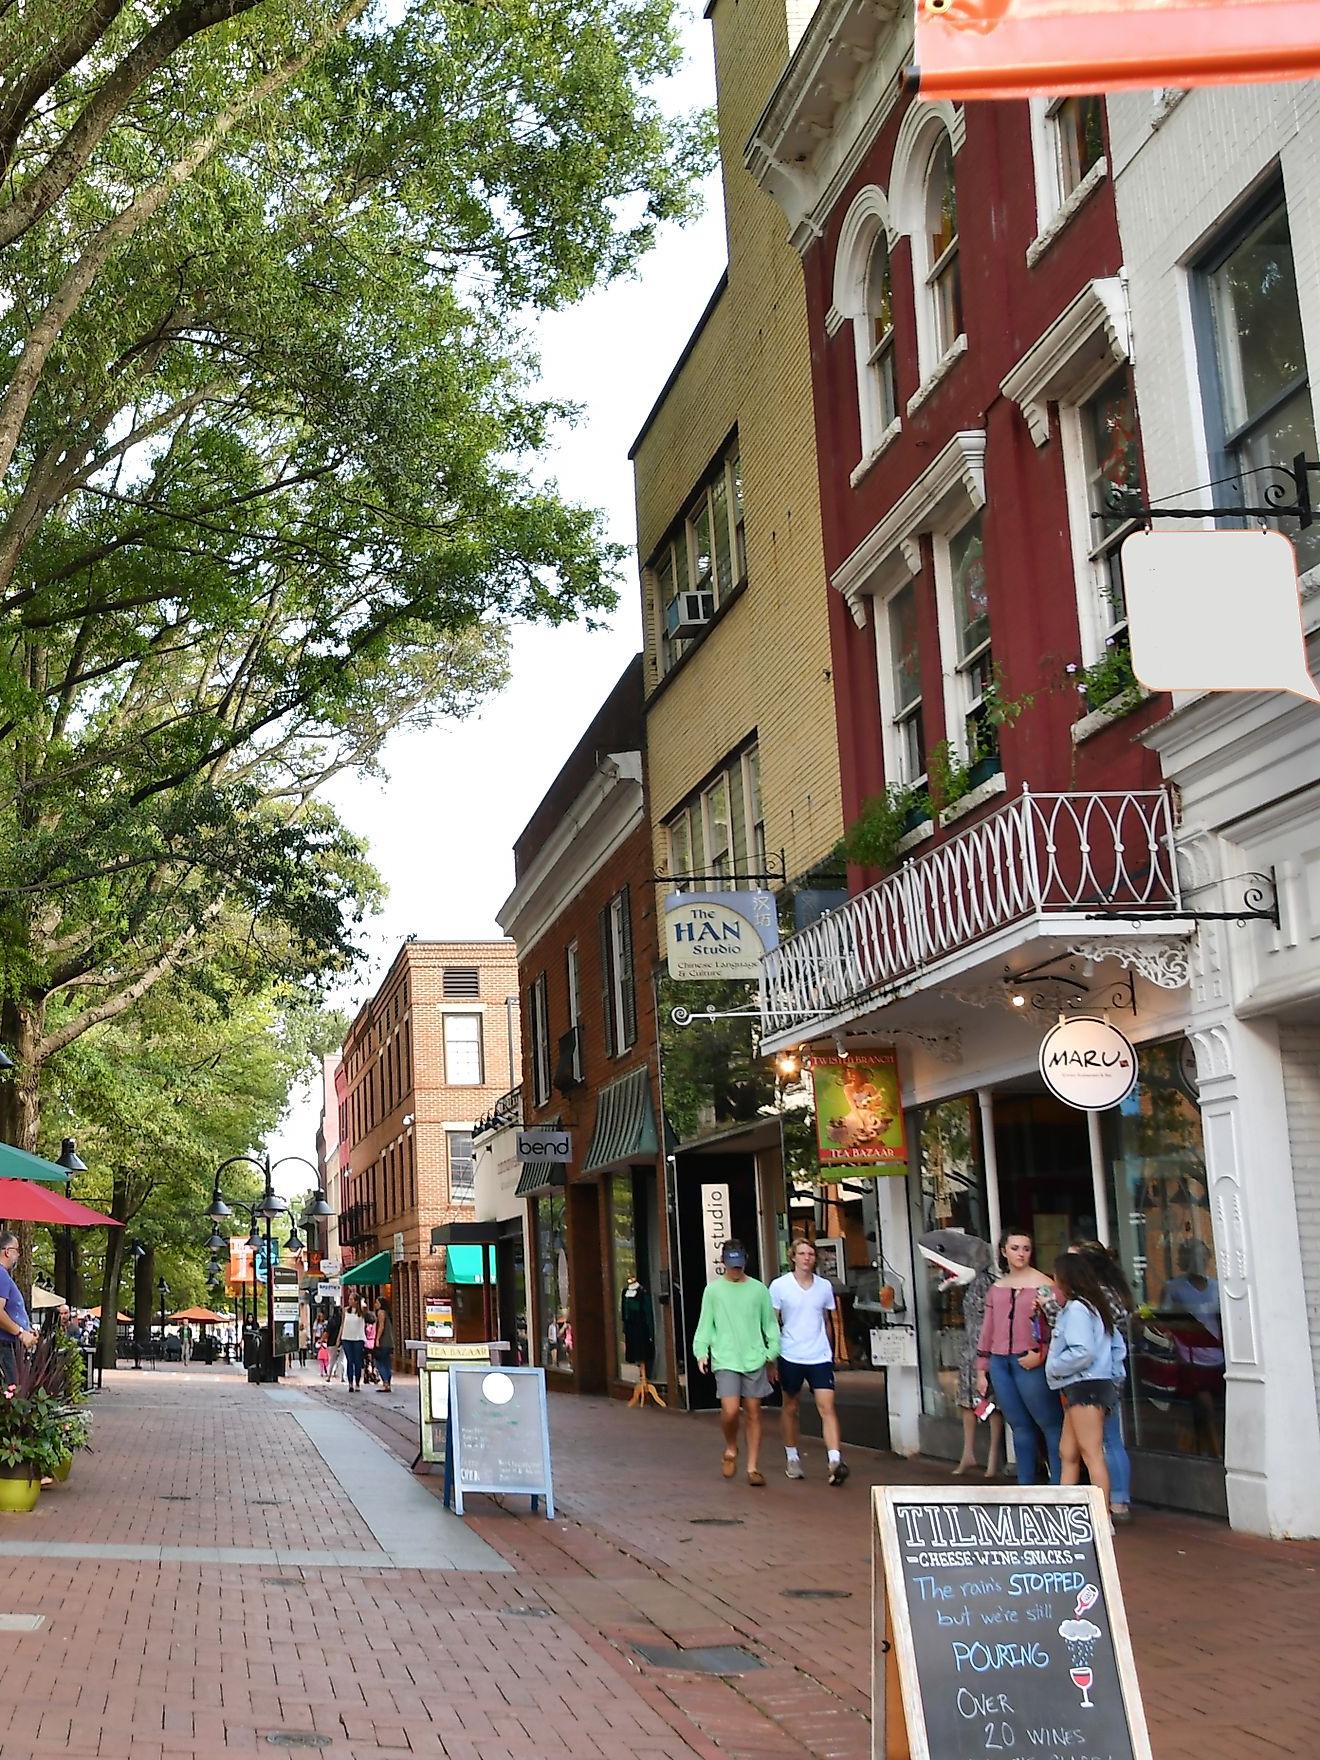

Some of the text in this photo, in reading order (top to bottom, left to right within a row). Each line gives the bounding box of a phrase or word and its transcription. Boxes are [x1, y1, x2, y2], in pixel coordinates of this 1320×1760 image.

[690, 908, 716, 919] The
[674, 921, 741, 942] HAN
[692, 944, 741, 955] Studio
[677, 960, 758, 970] Chinese Language
[855, 1055, 895, 1064] BRANCH
[1049, 1050, 1121, 1068] MARU
[519, 1136, 569, 1155] bend
[830, 1147, 894, 1159] TEA BAZAAR
[707, 1190, 725, 1250] studio
[449, 1346, 487, 1357] BAZAAR
[897, 1505, 1093, 1547] TILMANS
[918, 1550, 1073, 1567] CHEESE WINE SNACKS
[913, 1571, 1084, 1601] The rain's STOPPED
[937, 1604, 1052, 1627] but we're still
[952, 1640, 1049, 1672] POURING
[956, 1687, 1015, 1719] OVER
[984, 1722, 1086, 1750] 20 WINES
